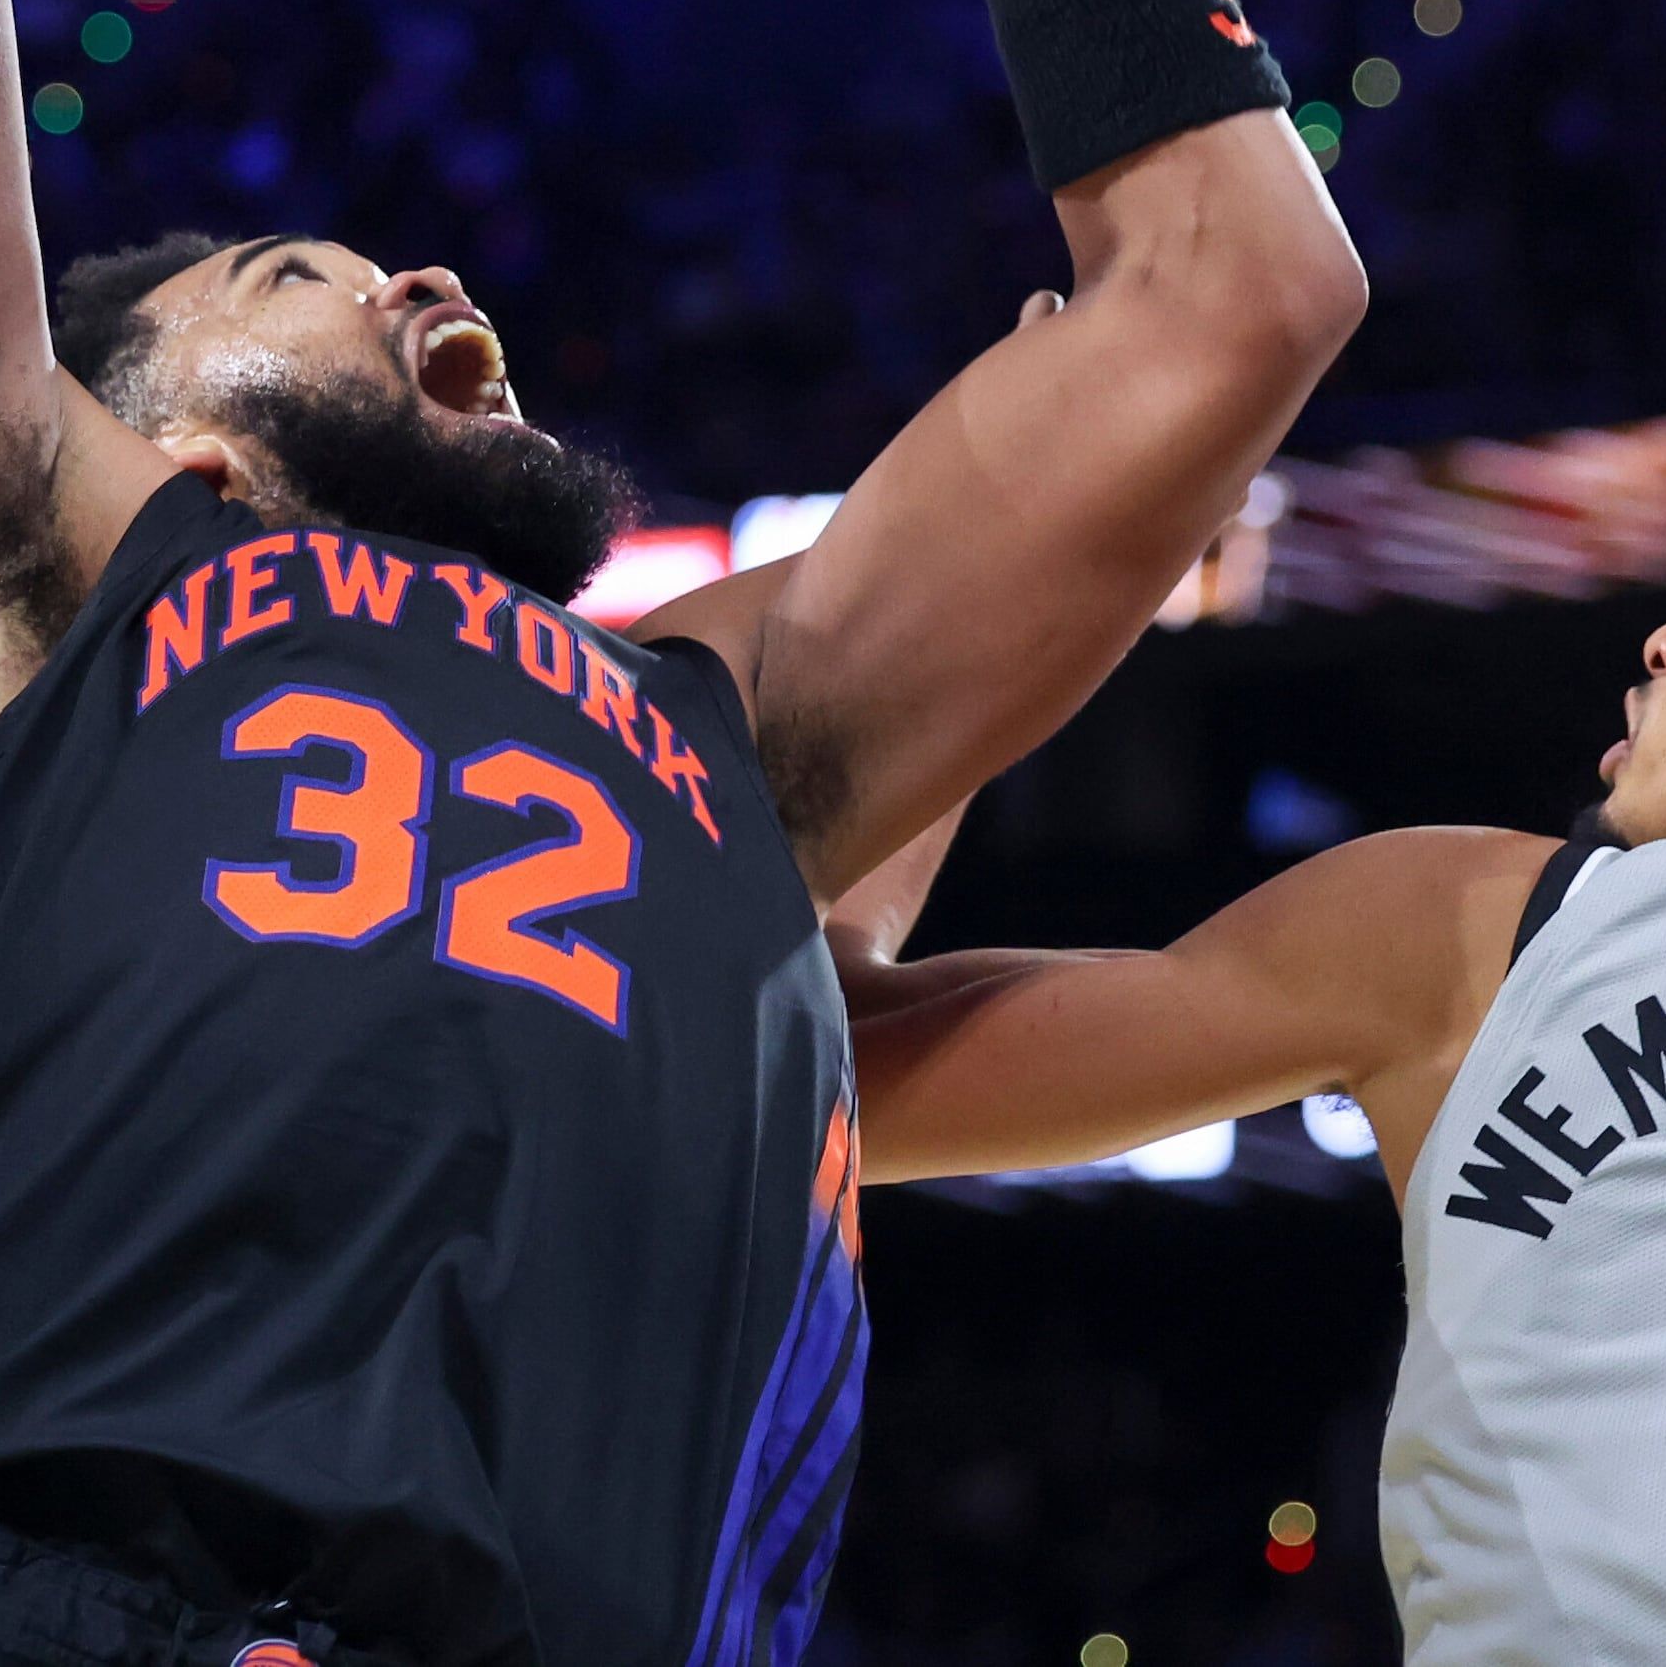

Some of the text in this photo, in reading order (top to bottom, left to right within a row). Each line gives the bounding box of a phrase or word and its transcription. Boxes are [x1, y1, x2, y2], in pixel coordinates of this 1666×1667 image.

[137, 530, 415, 714] NEW
[432, 564, 723, 847] YORK
[203, 684, 641, 1040] 32
